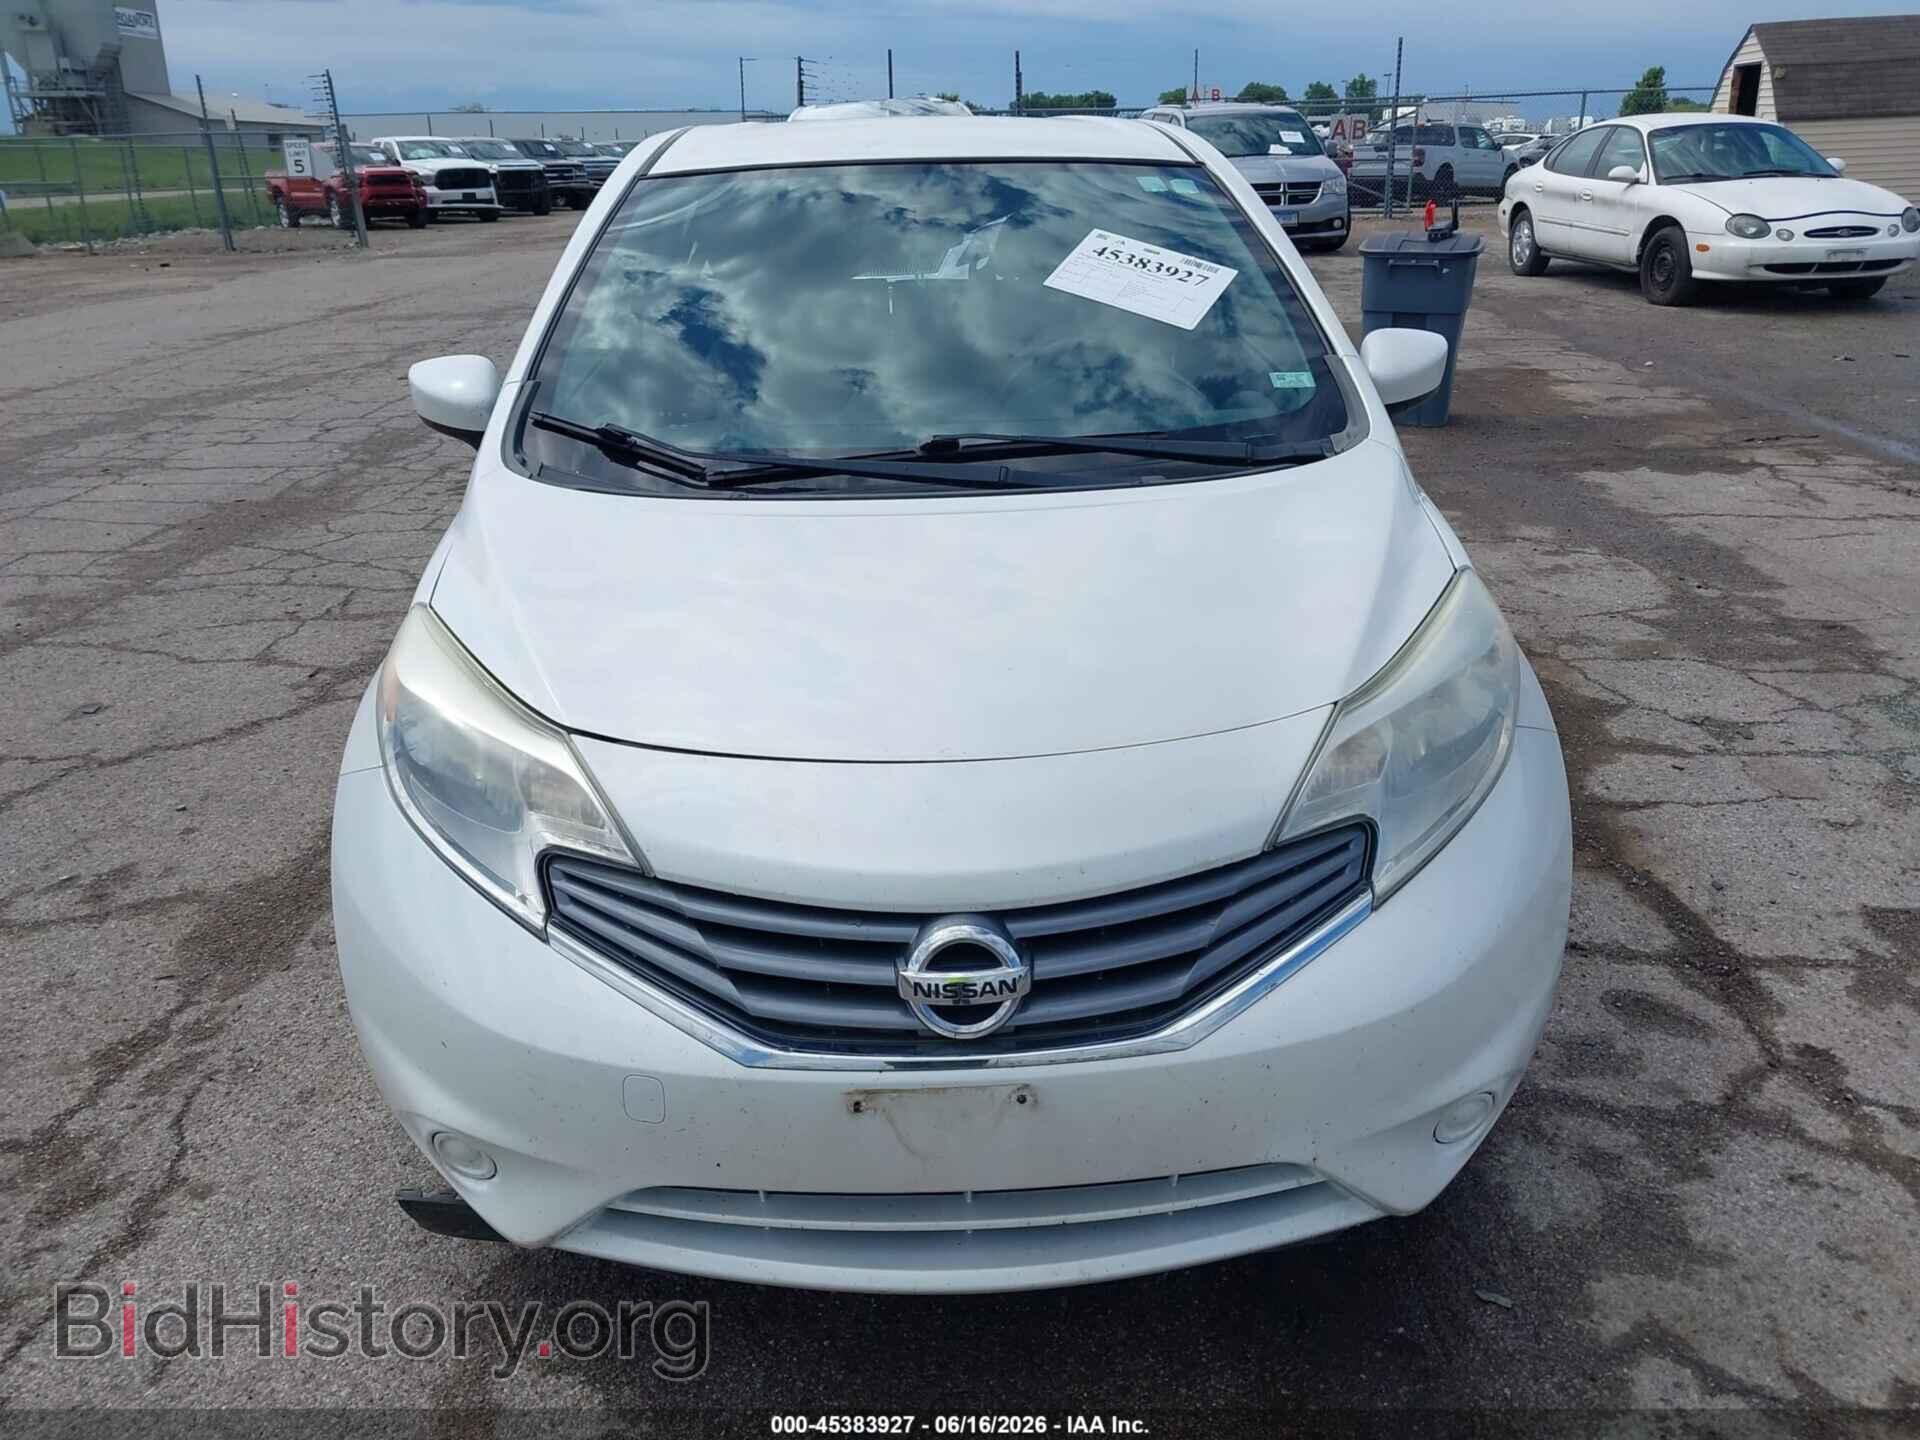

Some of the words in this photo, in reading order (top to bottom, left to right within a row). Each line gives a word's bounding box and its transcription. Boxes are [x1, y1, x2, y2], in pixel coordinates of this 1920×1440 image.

[1211, 88, 1220, 102] B
[1331, 119, 1347, 140] A
[1352, 119, 1366, 140] B
[294, 159, 305, 174] 5
[1092, 246, 1210, 287] 45383927
[912, 977, 1018, 999] NISSAN
